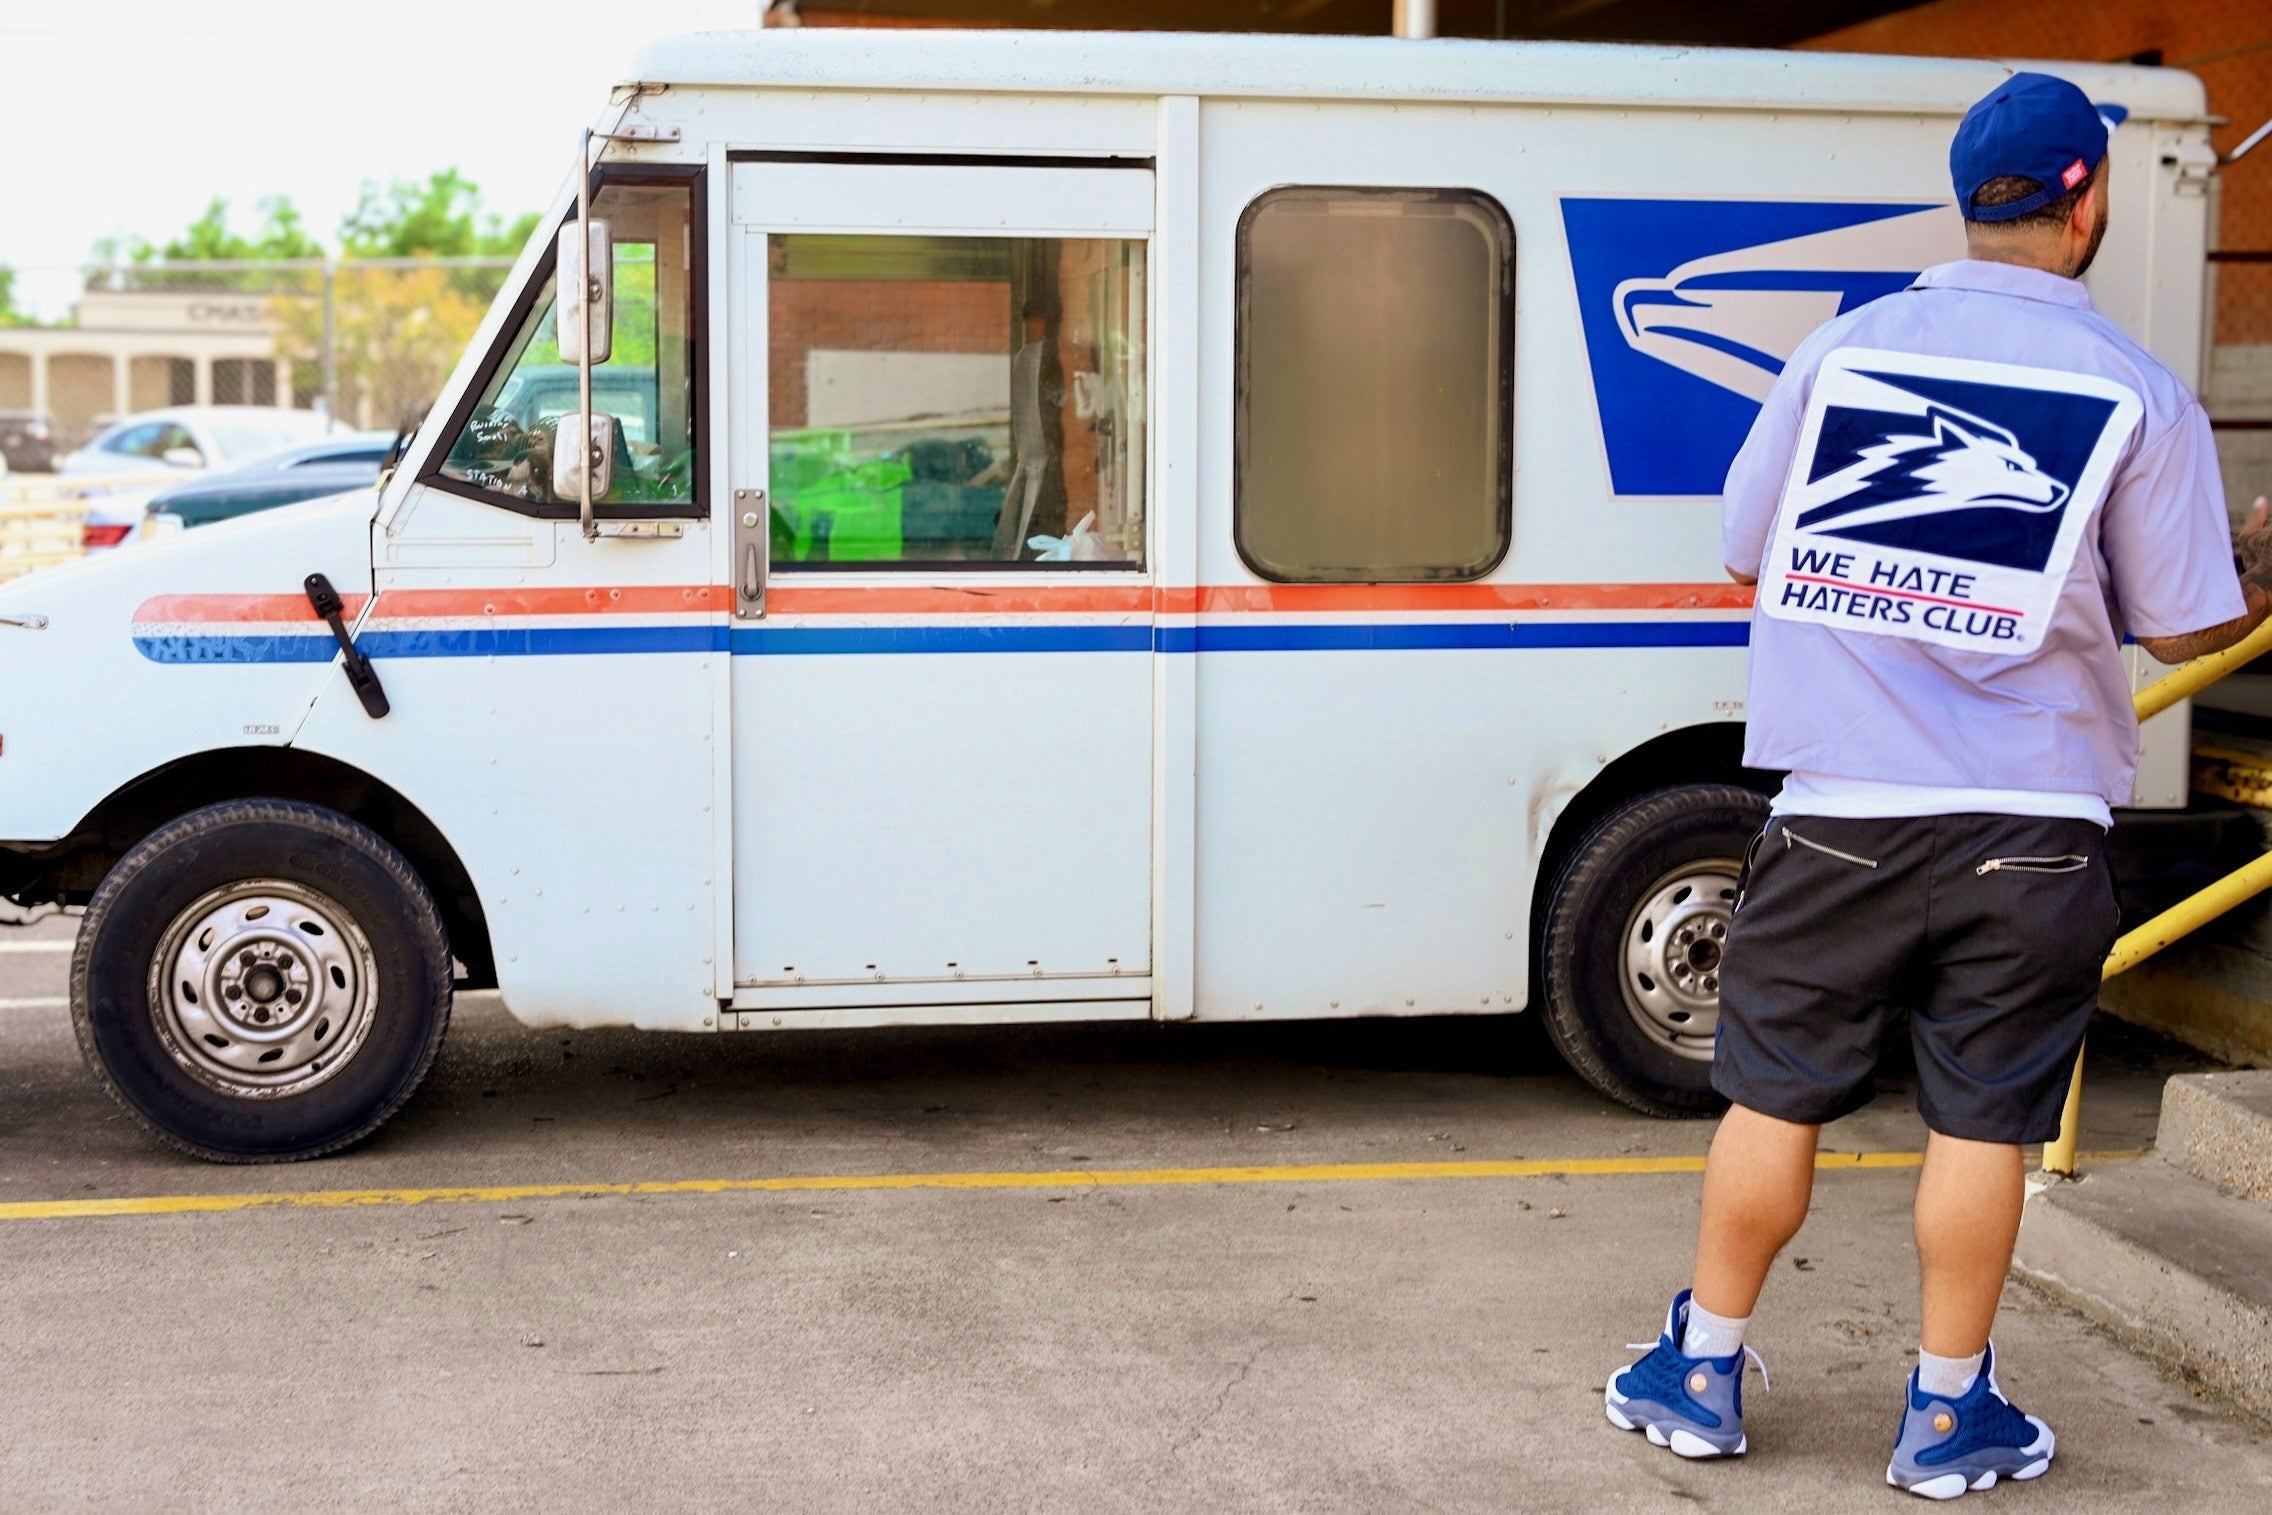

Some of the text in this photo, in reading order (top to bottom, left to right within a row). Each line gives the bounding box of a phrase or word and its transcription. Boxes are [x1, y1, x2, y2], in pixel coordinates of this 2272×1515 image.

[466, 468, 513, 490] STATION
[1792, 547, 1977, 600] WE HATE
[1780, 582, 1914, 624] HATERS
